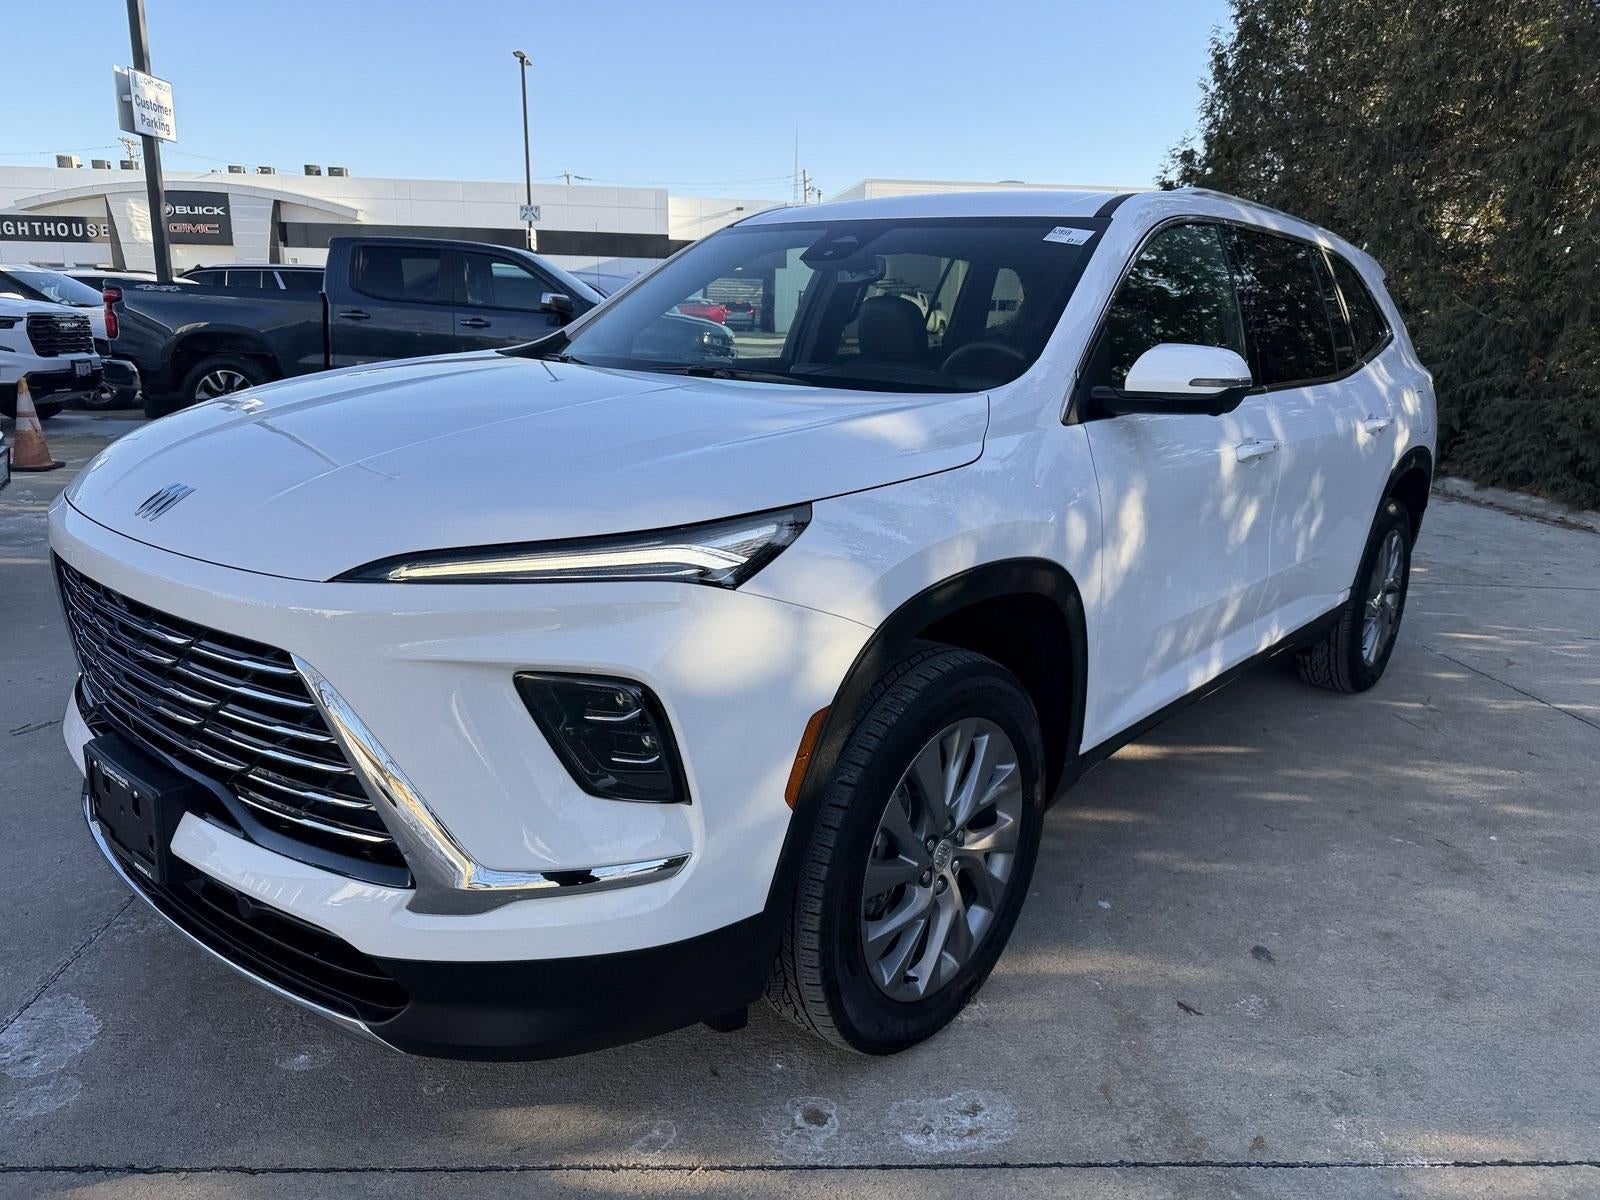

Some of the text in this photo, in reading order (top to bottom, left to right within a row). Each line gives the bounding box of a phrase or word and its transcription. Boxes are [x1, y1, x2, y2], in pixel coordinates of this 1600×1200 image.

[134, 94, 172, 117] Customer
[140, 113, 171, 136] Parking
[175, 205, 226, 215] BUICK
[0, 220, 110, 238] GHTHOUSE
[169, 222, 220, 234] GMC
